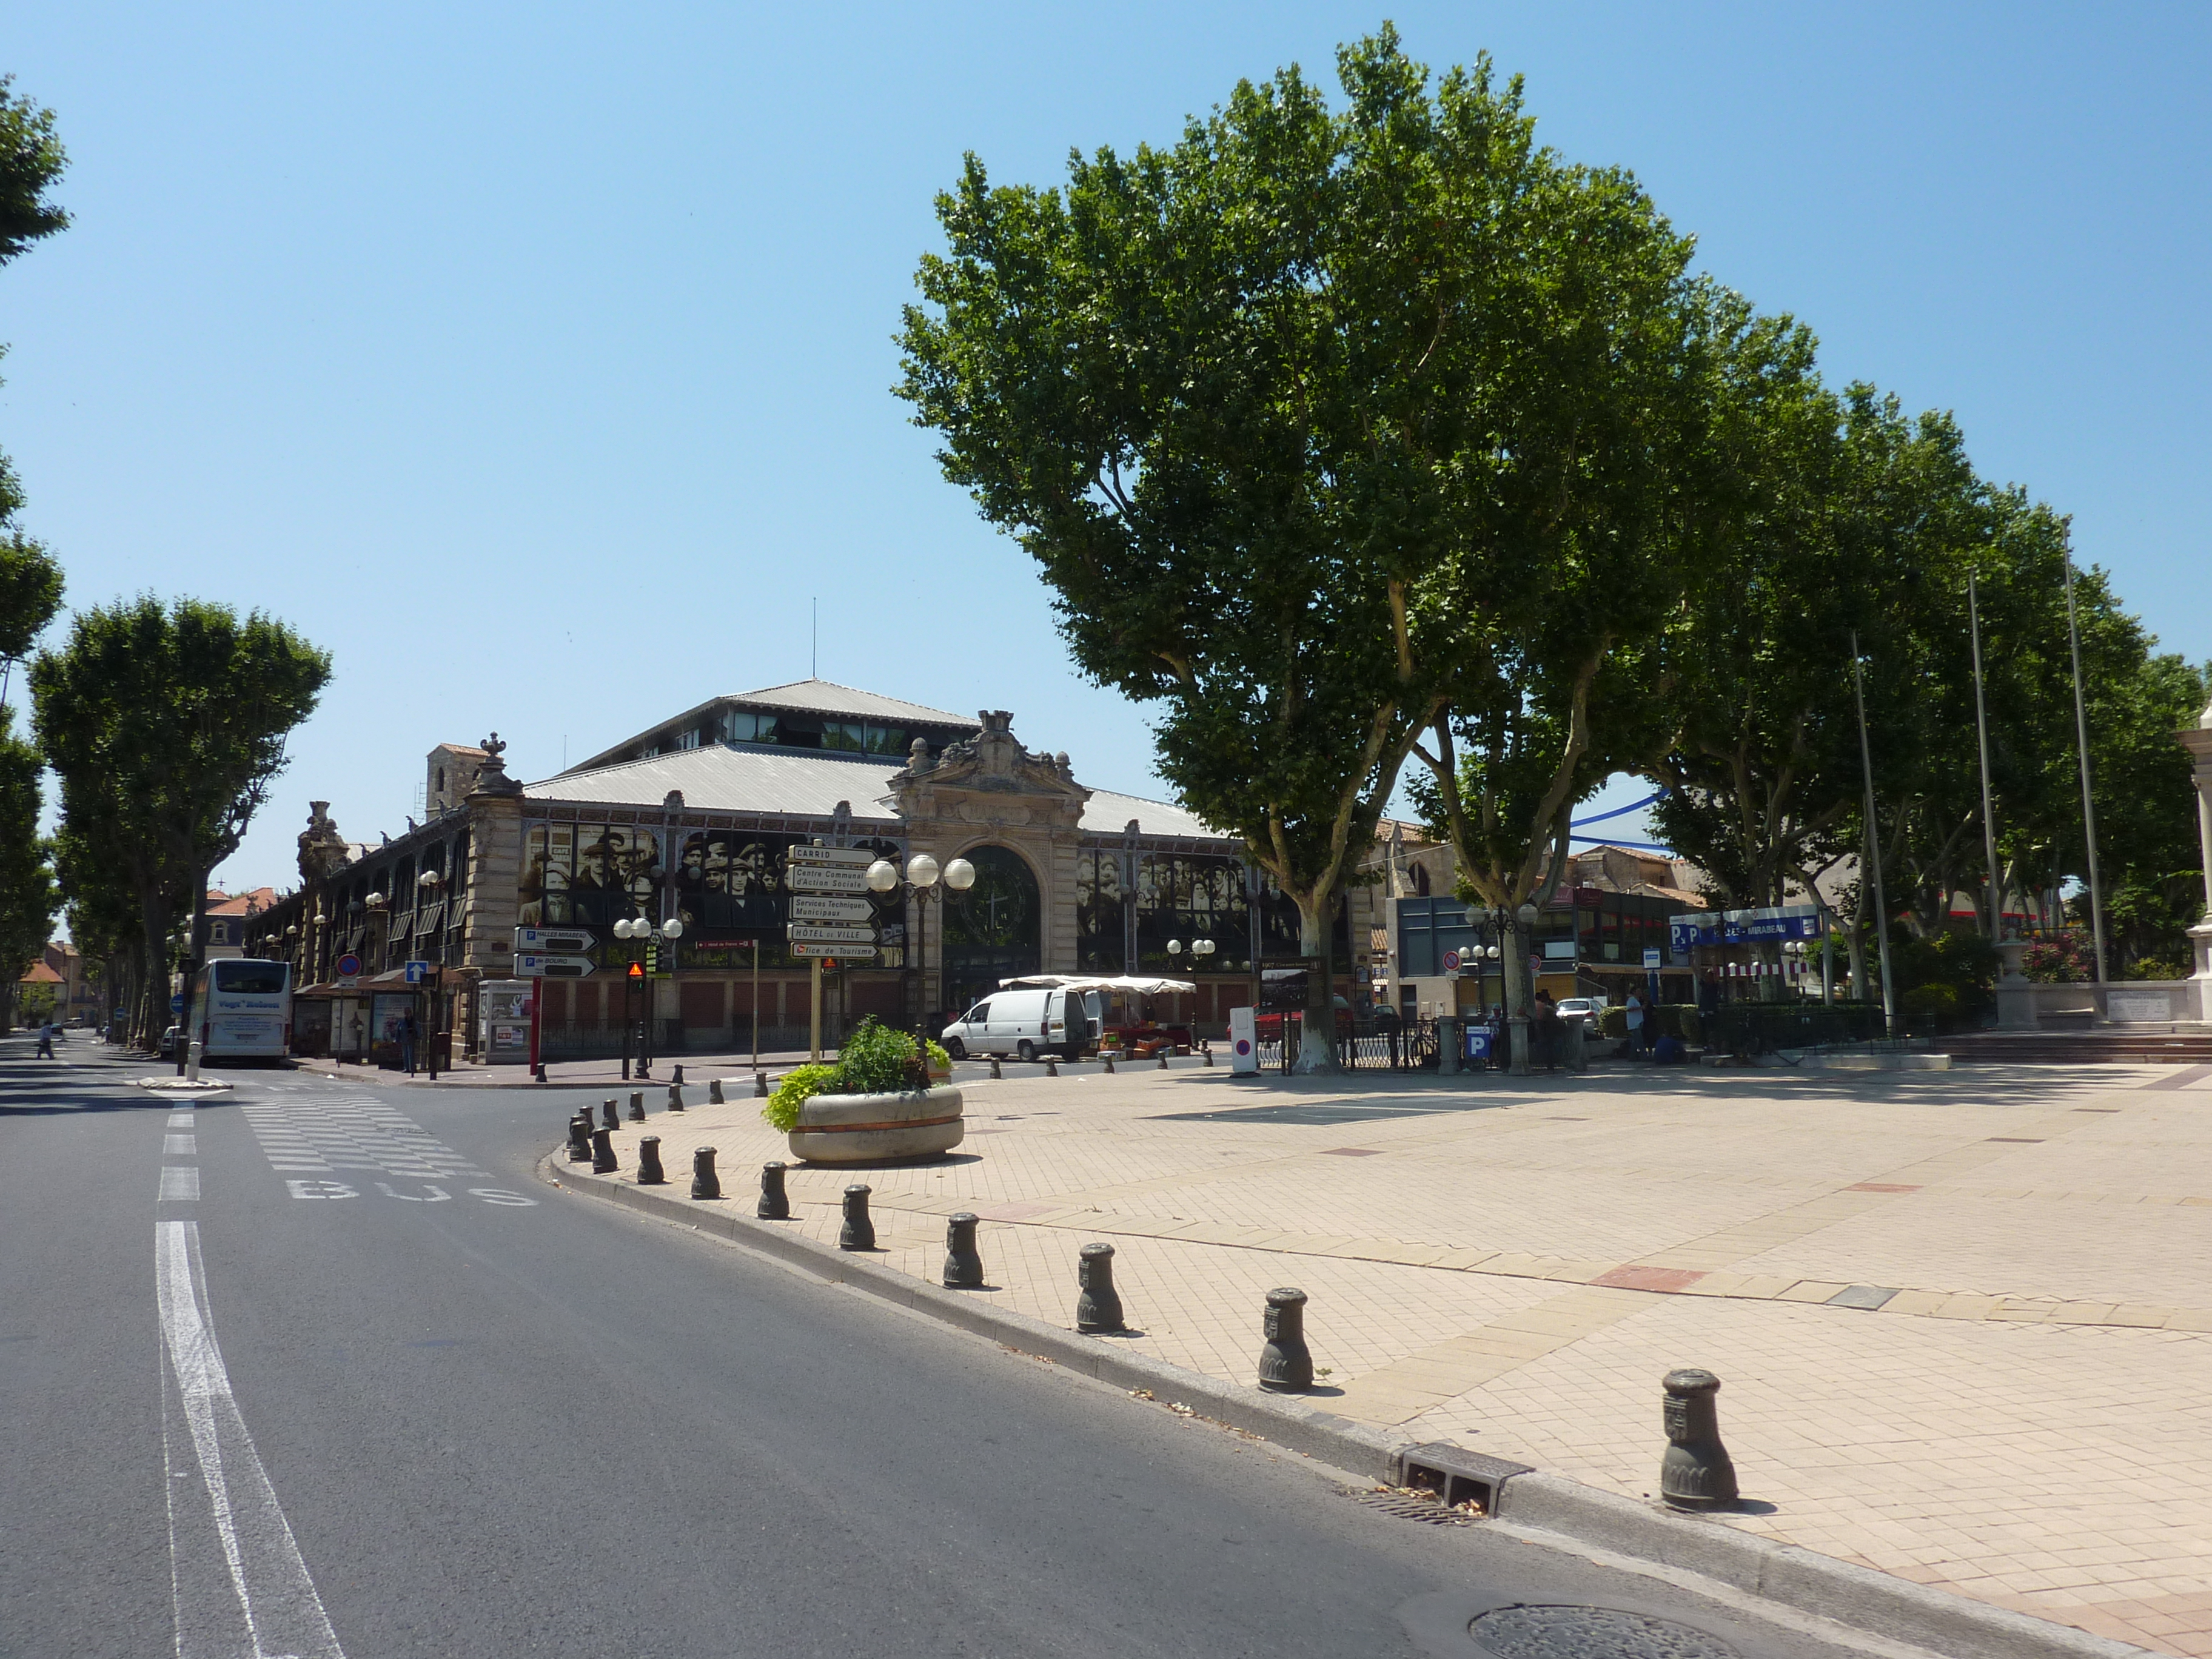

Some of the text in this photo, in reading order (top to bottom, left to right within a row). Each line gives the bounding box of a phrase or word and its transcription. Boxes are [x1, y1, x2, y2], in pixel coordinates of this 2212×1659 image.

[797, 850, 830, 858] CARRID
[825, 871, 863, 879] Communal
[828, 900, 865, 910] Techniques
[796, 908, 840, 917] Municipaux
[795, 928, 823, 937] HÔTEL
[1748, 924, 1786, 935] MIRABEAU
[1671, 925, 1681, 945] P
[797, 945, 820, 954] fice
[1471, 1036, 1485, 1055] P
[284, 1179, 540, 1207] BUS
